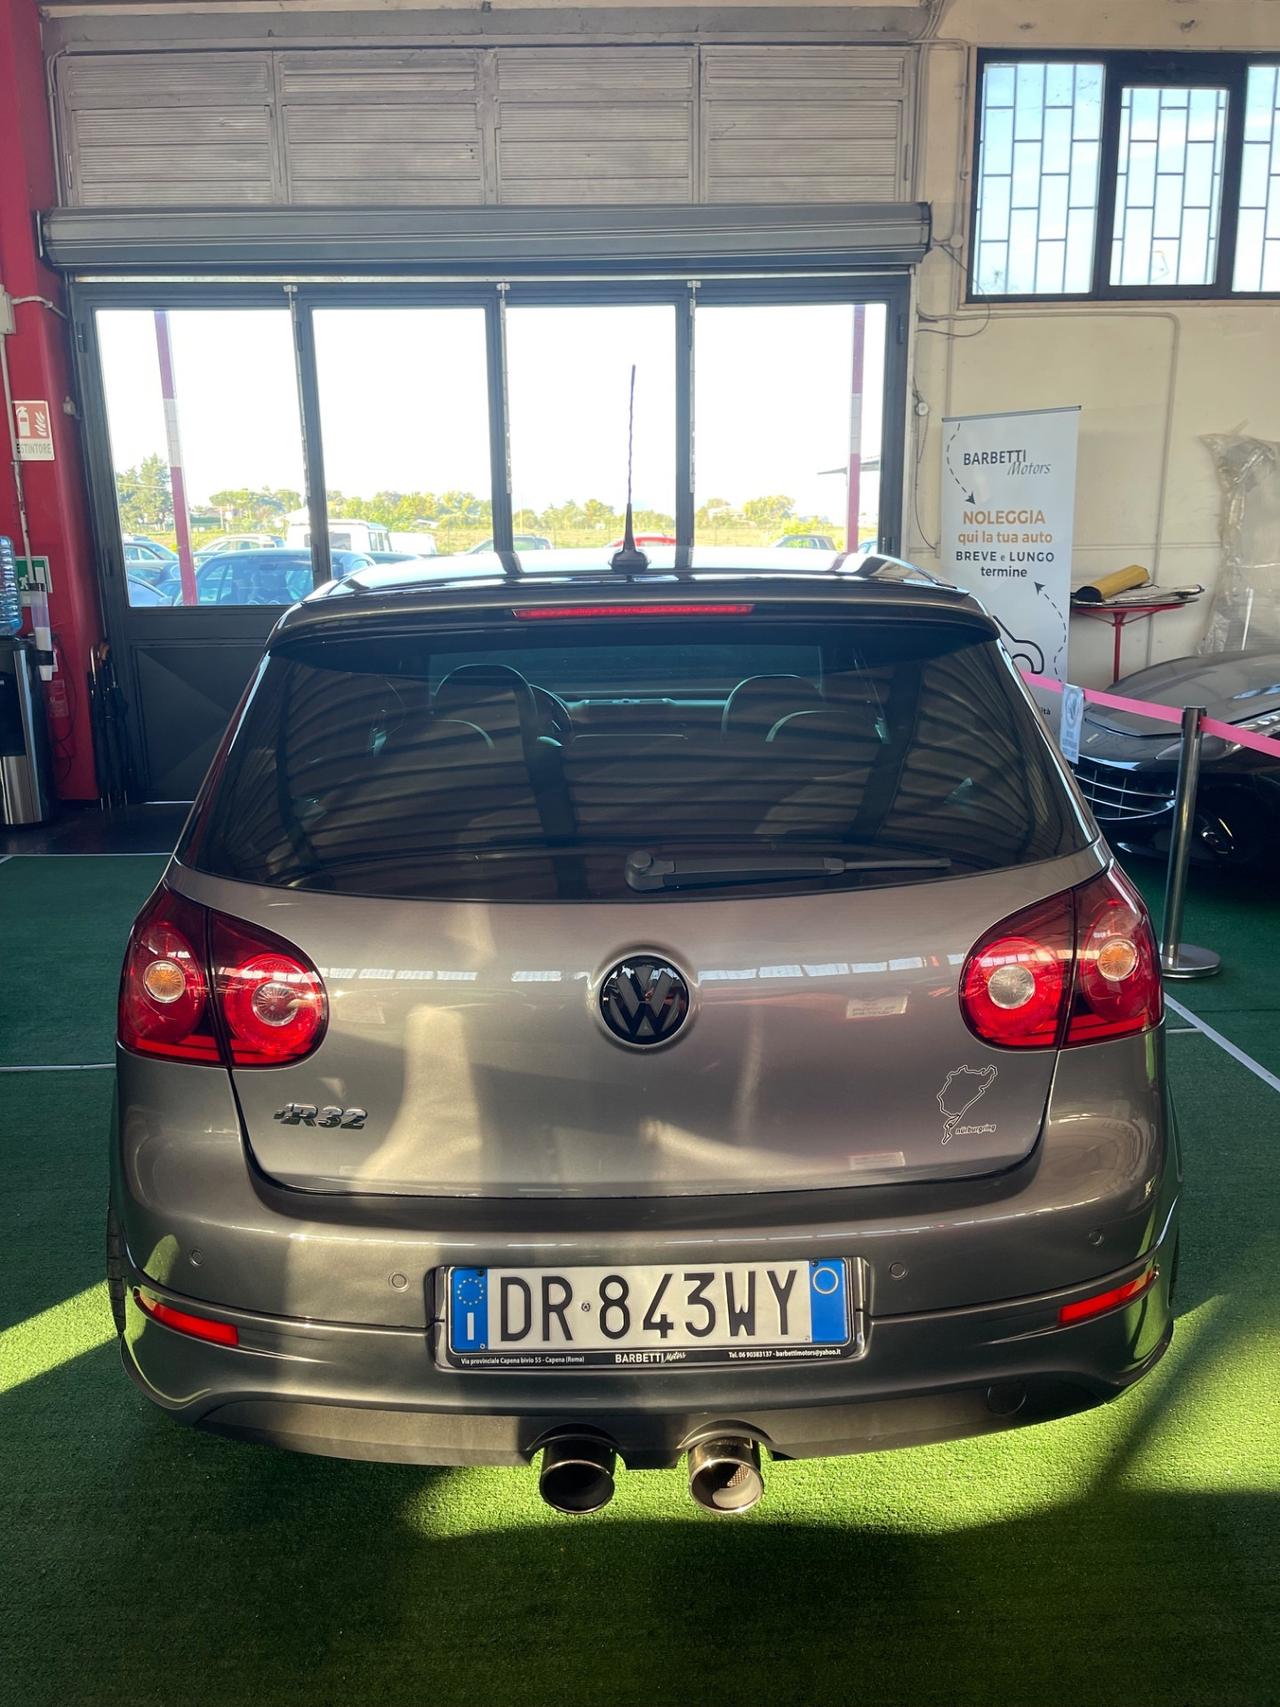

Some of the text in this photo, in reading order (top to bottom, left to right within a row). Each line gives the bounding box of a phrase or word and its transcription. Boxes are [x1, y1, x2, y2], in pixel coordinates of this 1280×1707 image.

[963, 450, 1027, 466] BARBETTI
[1007, 462, 1052, 476] Motors
[963, 510, 1046, 525] NOLEGGIA
[958, 530, 1053, 545] qui la tua auto
[955, 551, 1055, 562] BREVE e LUNGO
[980, 566, 1028, 578] termine
[470, 1357, 499, 1366] provinciale
[500, 1357, 520, 1366] Capena
[545, 1356, 565, 1365] Capena
[565, 1356, 585, 1364] (Roma)
[615, 1352, 664, 1363] BARBETTI
[728, 1351, 739, 1359] Tel.
